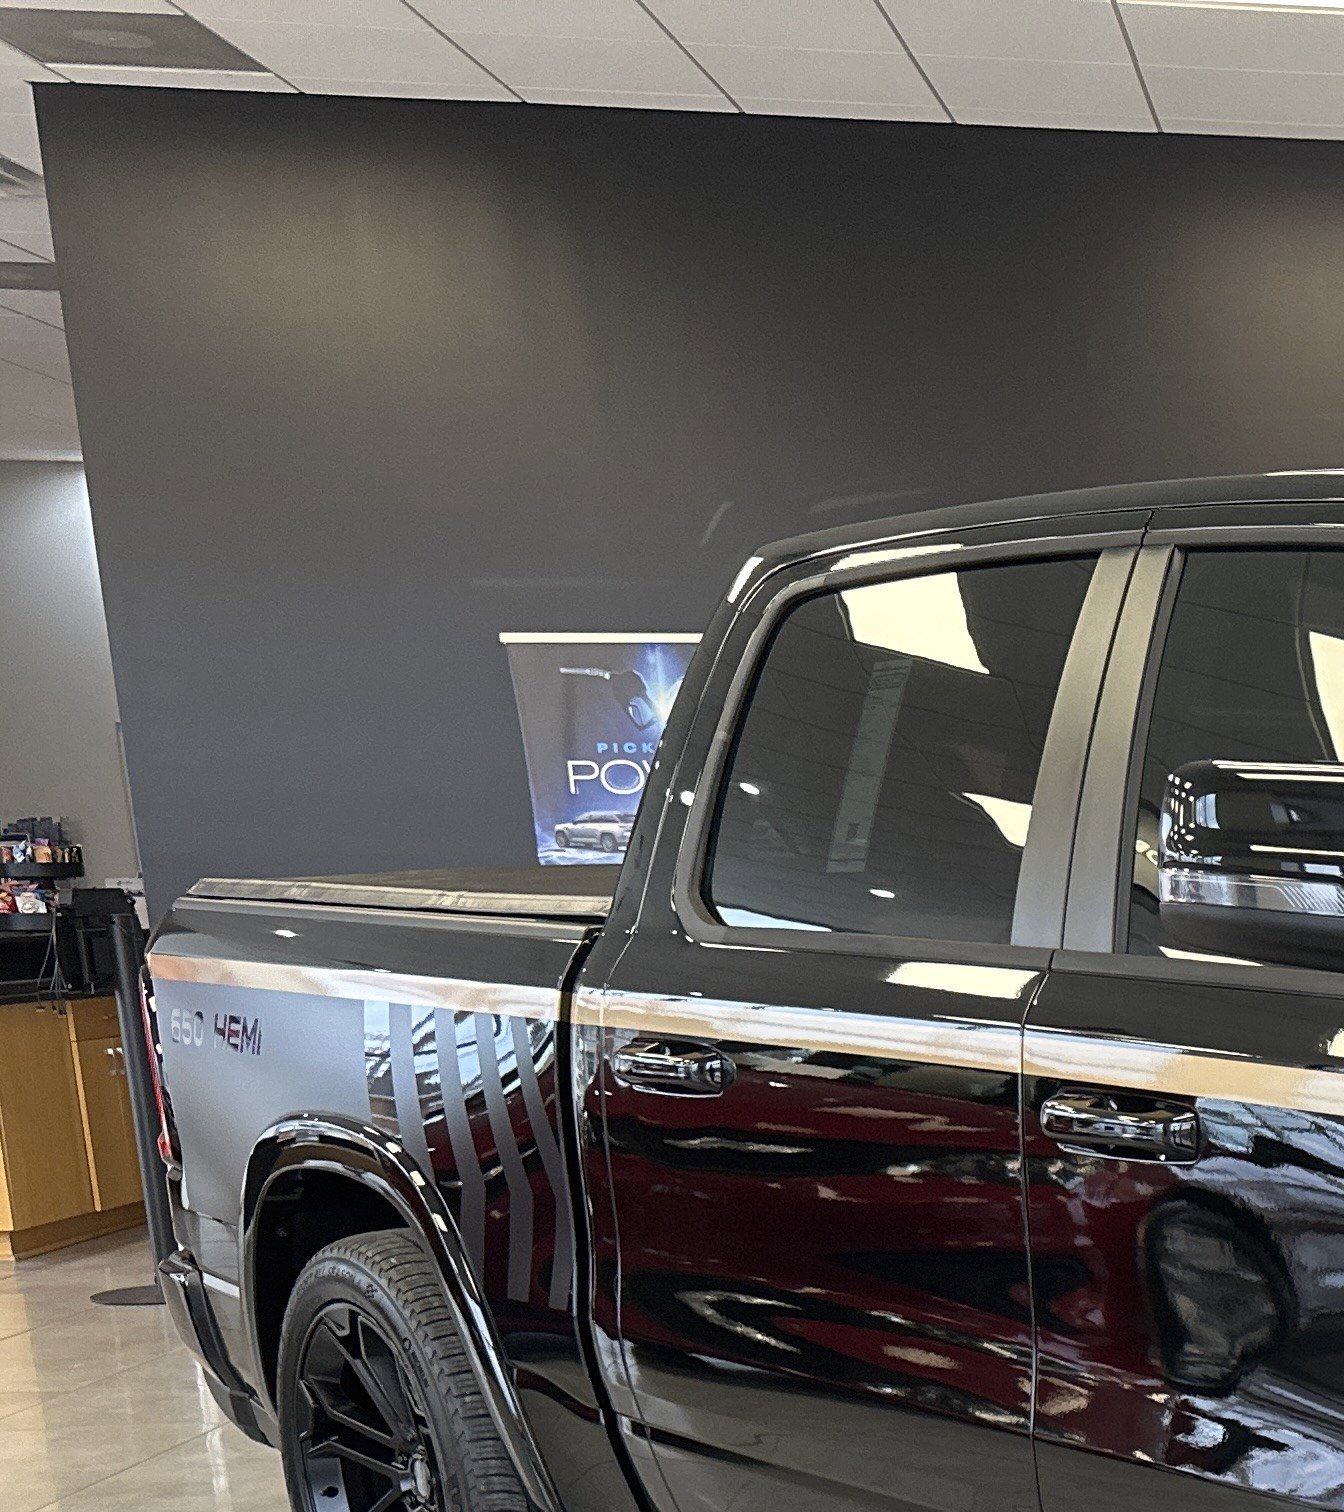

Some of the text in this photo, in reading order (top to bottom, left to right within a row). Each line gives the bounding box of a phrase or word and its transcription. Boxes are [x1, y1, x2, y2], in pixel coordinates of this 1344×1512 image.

[597, 742, 656, 754] PICK
[567, 759, 652, 795] PO
[170, 1008, 263, 1056] 650 HEMI
